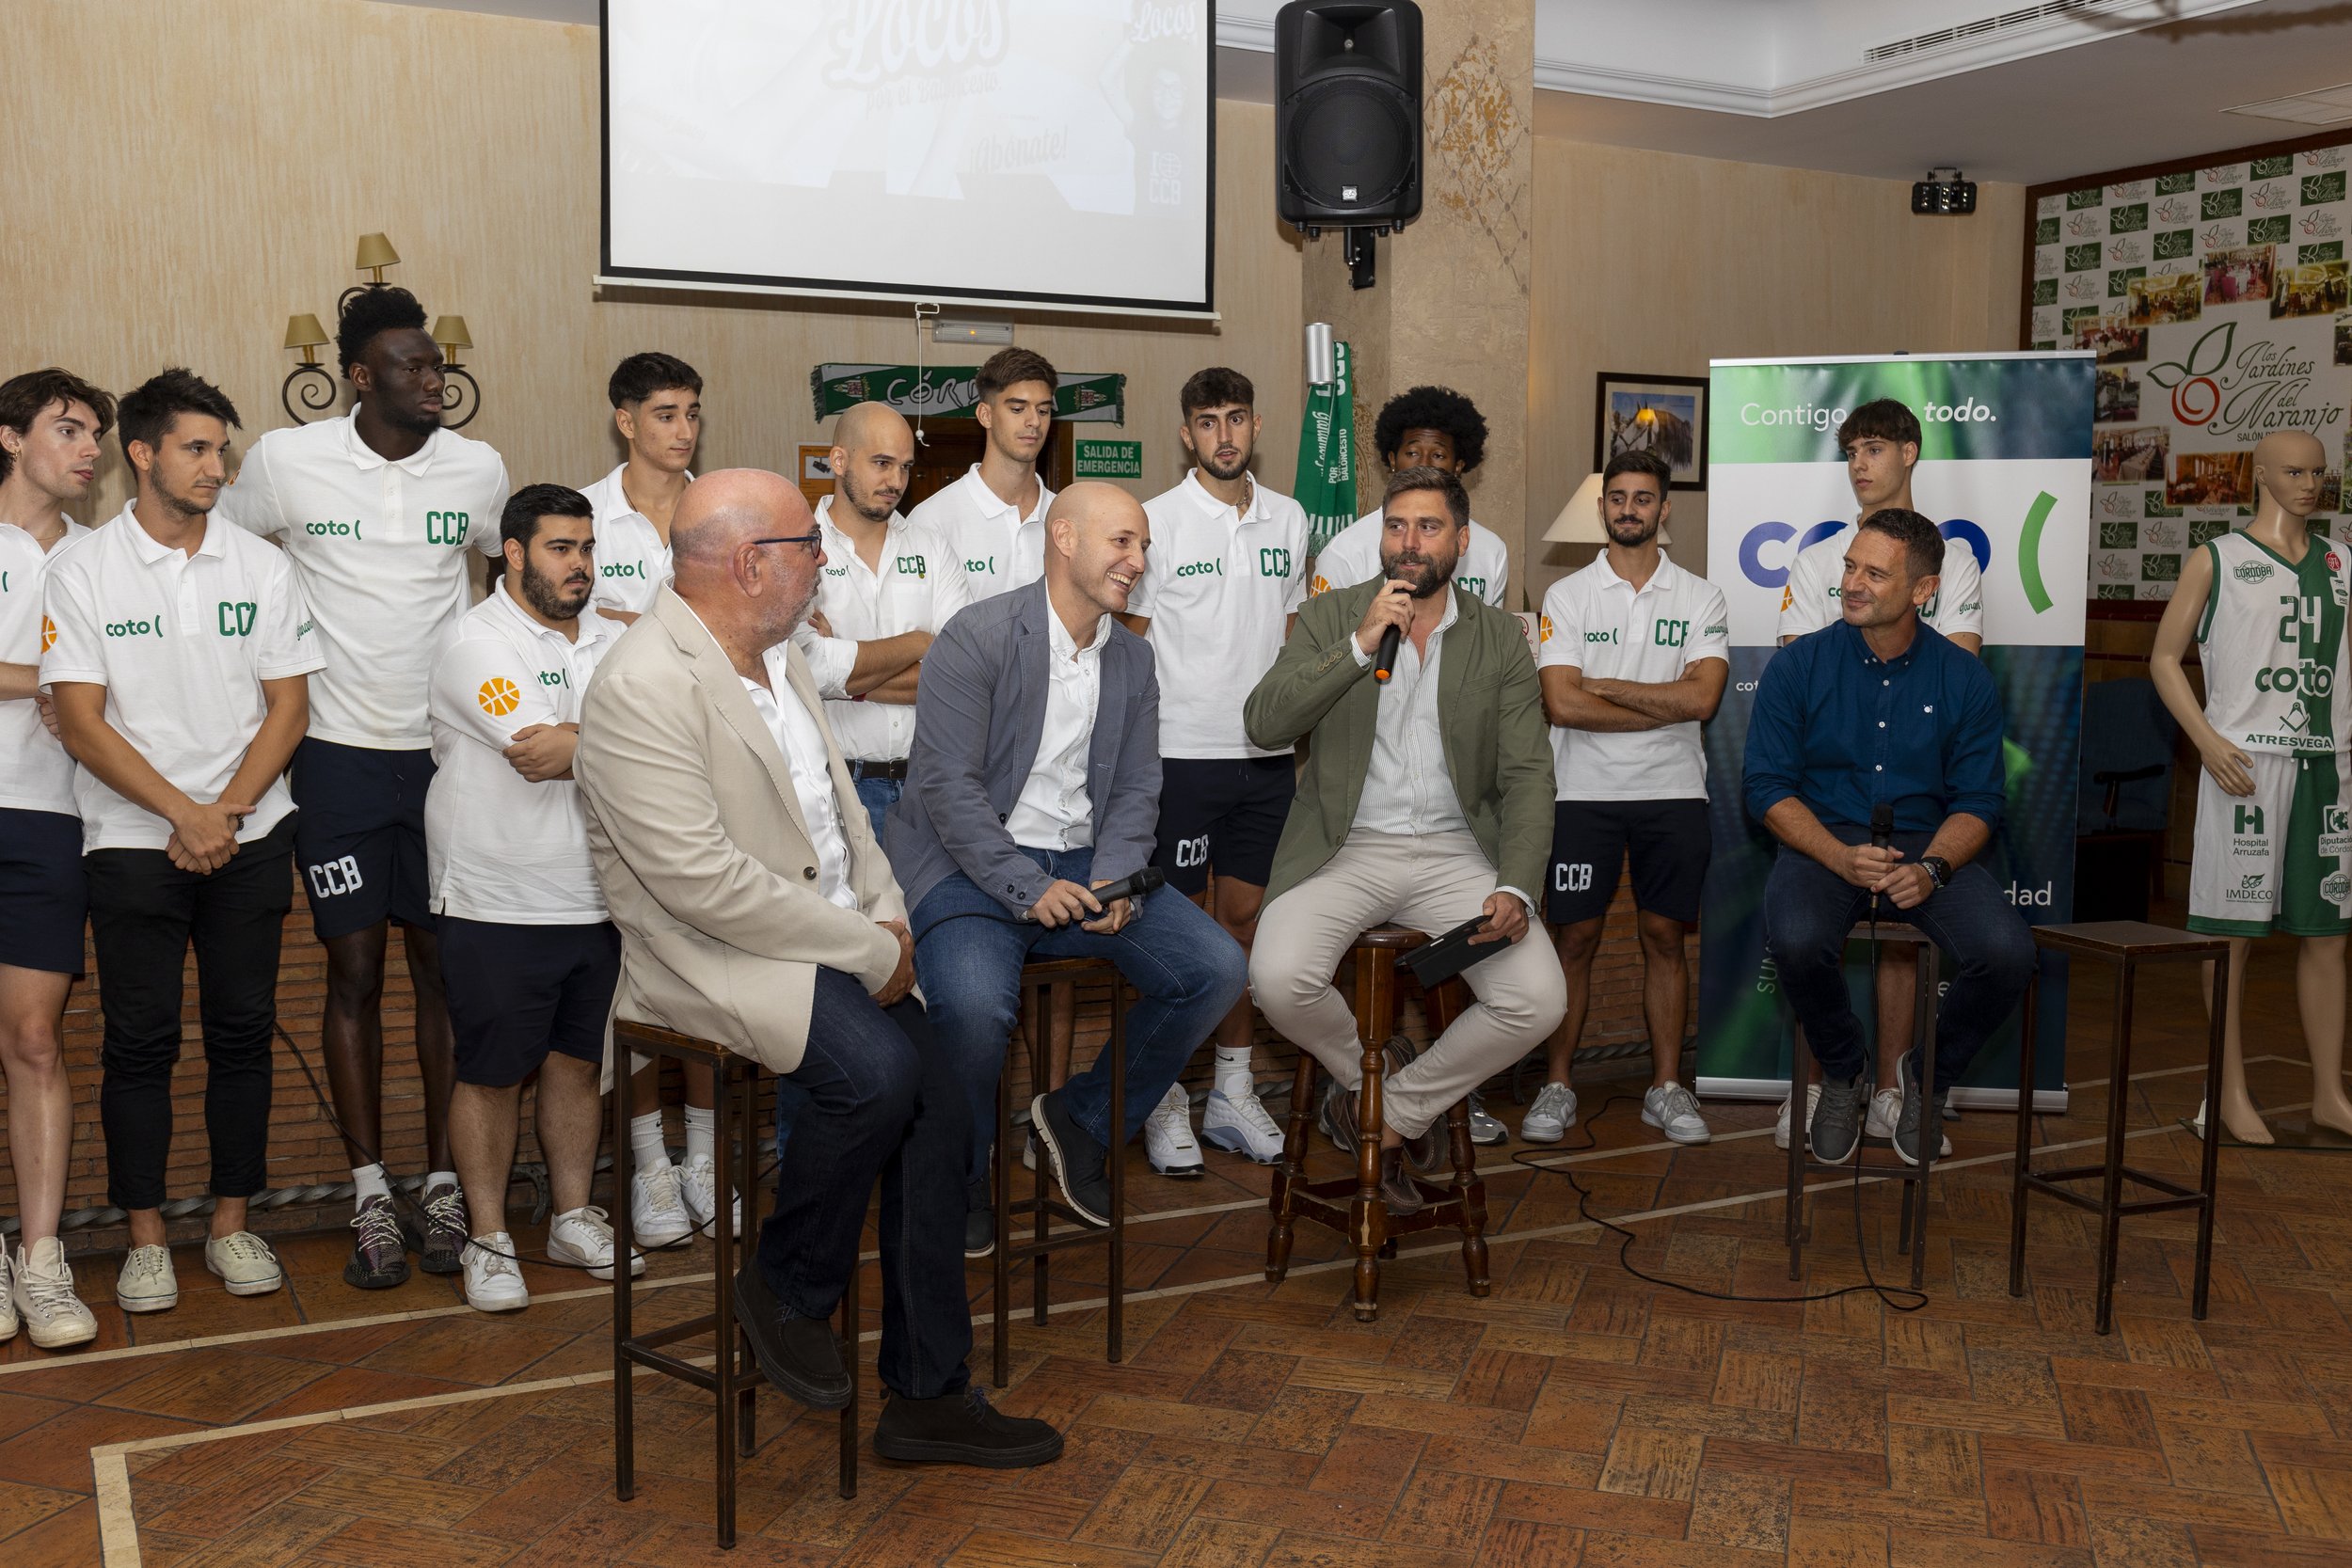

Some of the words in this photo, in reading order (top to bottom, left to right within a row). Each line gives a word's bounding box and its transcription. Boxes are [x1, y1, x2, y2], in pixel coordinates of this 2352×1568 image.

[1740, 403, 1847, 432] Contigo
[1923, 396, 1996, 422] todo.
[1084, 445, 1119, 458] SALIDA
[1121, 447, 1134, 459] DE
[1077, 460, 1140, 474] EMERGENCIA
[427, 511, 469, 546] CCB
[600, 562, 635, 578] oto
[897, 555, 927, 576] CCB
[1260, 547, 1290, 578] CCB
[2280, 595, 2322, 643] 24
[1584, 629, 1610, 642] oto
[2255, 661, 2332, 693] coto
[2246, 734, 2332, 749] ATRESVEGA
[1176, 833, 1209, 867] CCB
[2233, 838, 2269, 847] Hospital
[2233, 847, 2269, 856] Arruzafa
[2320, 837, 2352, 846] Diputació
[310, 855, 363, 898] CCB
[1555, 863, 1593, 894] CCB
[2226, 889, 2273, 900] IMDECO
